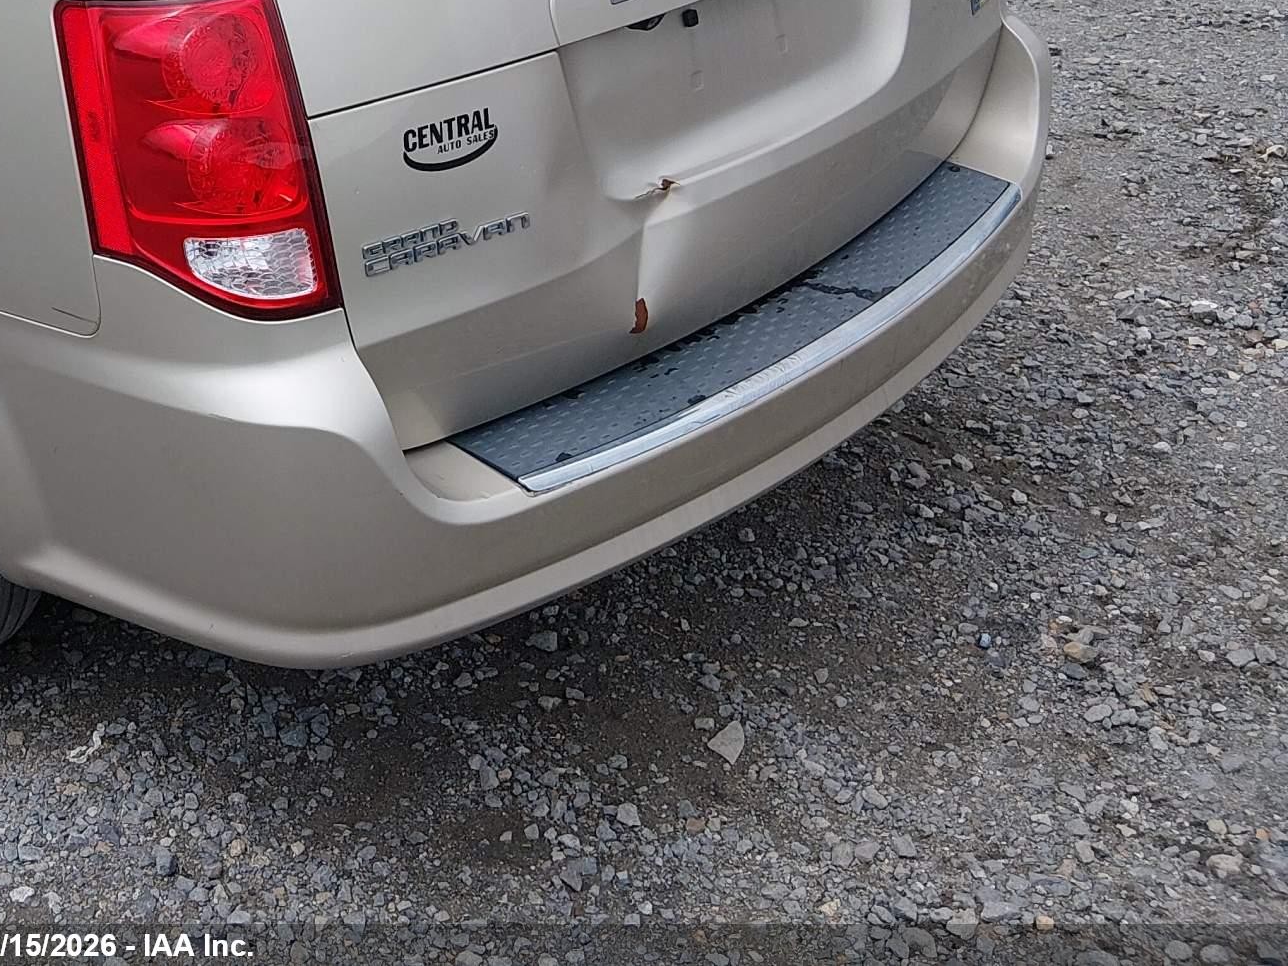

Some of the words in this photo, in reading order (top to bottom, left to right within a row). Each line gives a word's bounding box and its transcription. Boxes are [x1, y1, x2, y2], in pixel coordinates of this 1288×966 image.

[403, 107, 495, 153] CENTRAL
[437, 141, 462, 154] AUTO
[466, 129, 494, 146] SALES
[362, 218, 460, 259] GRAND
[365, 211, 530, 276] CARAVAN
